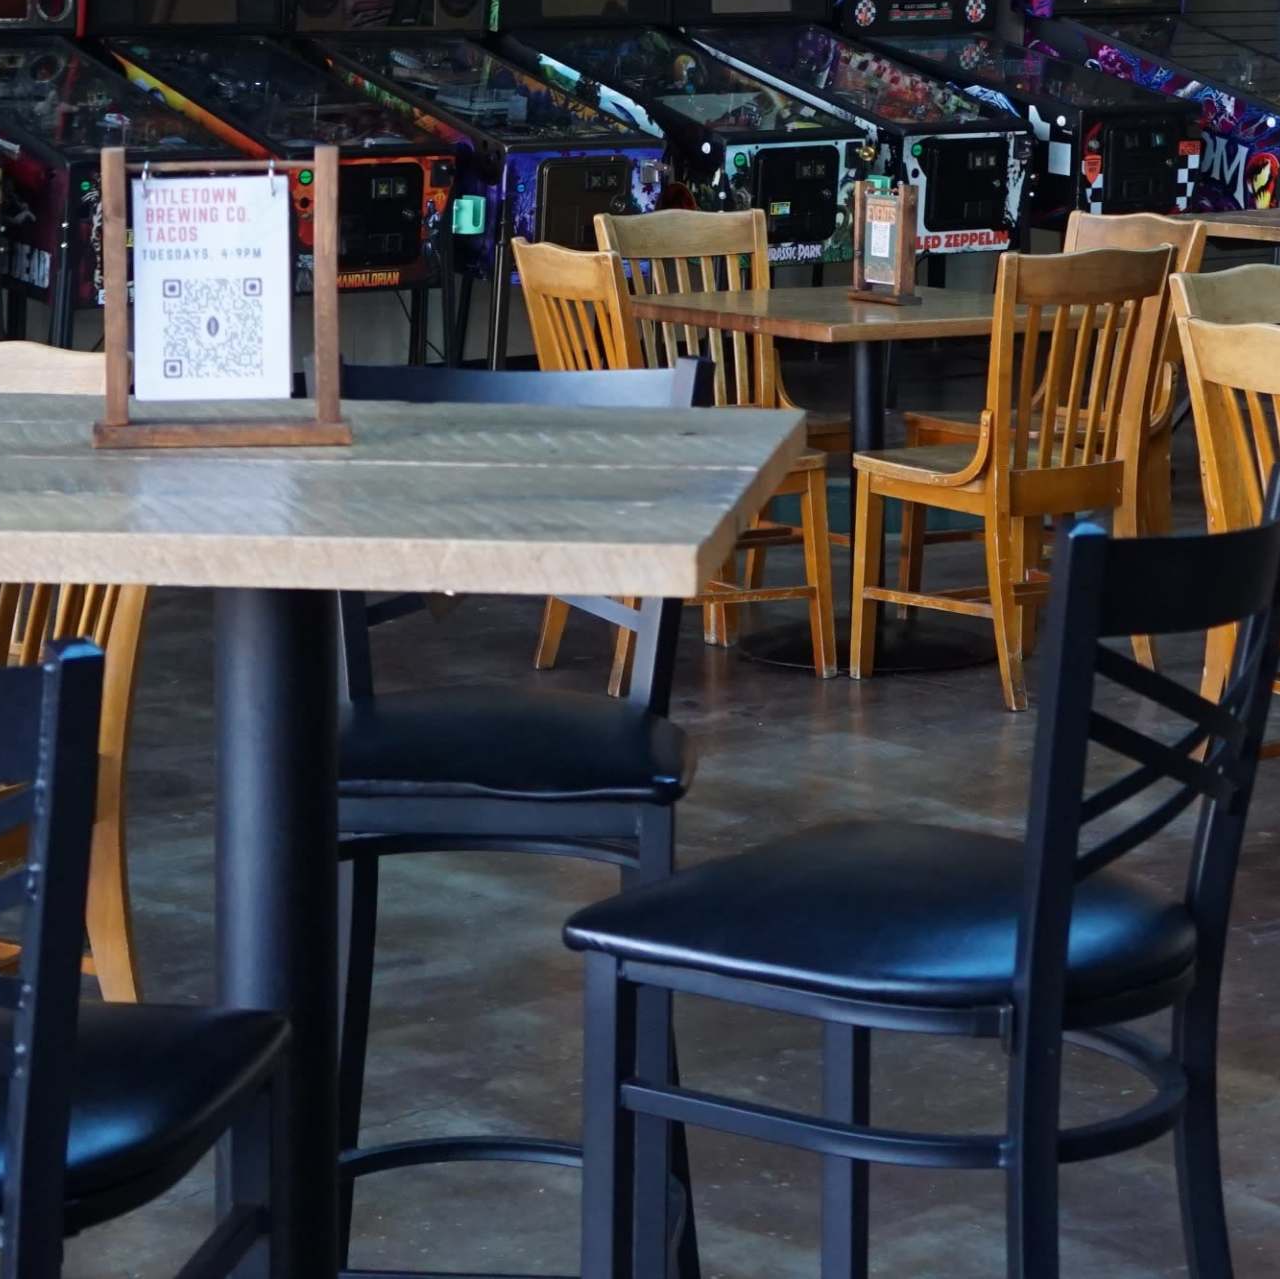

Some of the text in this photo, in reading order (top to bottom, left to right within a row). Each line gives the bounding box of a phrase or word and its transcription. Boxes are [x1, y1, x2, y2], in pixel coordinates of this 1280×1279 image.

[146, 188, 238, 205] TITLETOWN
[146, 206, 251, 223] BREWING CO.
[146, 226, 198, 242] TACOS
[915, 229, 1009, 250] LED ZEPPELIN
[798, 243, 822, 260] PARK
